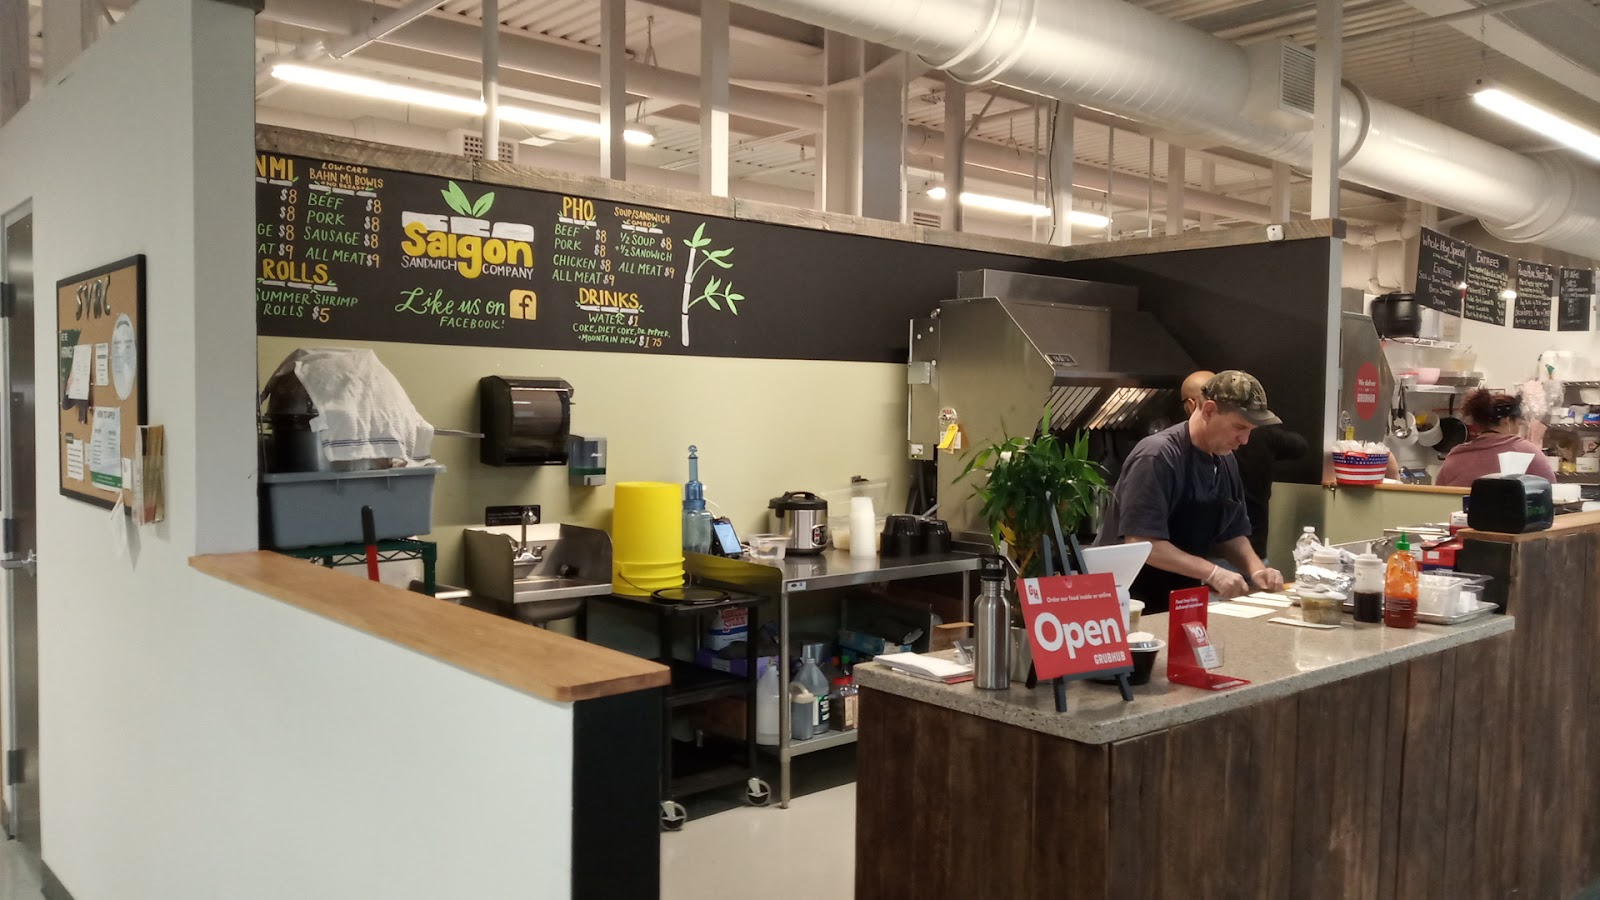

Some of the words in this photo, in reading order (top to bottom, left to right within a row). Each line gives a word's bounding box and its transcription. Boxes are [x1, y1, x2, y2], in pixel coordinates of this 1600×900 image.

[322, 162, 368, 174] LOW-CARB
[310, 168, 338, 182] BAHN
[340, 173, 352, 184] MI
[355, 176, 384, 188] BOWLS
[280, 188, 297, 204] $8
[308, 192, 344, 210] BEEF
[366, 199, 382, 214] $8
[280, 206, 295, 221] $8
[562, 196, 594, 220] PHO
[614, 206, 670, 224] SOUP/SANDWICH
[306, 210, 346, 226] PORK
[364, 216, 380, 232] $8
[258, 223, 273, 237] GE
[278, 224, 294, 240] $8
[304, 226, 360, 246] SAUSAGE
[364, 233, 379, 248] $8
[554, 224, 580, 237] BEEF
[596, 229, 606, 243] $8
[401, 222, 534, 279] Saigon
[554, 238, 582, 250] PORK
[594, 244, 606, 258] $8
[632, 234, 656, 246] SOUP
[660, 237, 672, 250] $8
[1422, 234, 1440, 250] Whole
[1440, 240, 1450, 257] Hog
[1450, 242, 1466, 258] Special
[278, 244, 294, 259] $9
[306, 247, 329, 262] ALL
[332, 250, 367, 266] MEAT
[366, 254, 380, 268] $9
[630, 247, 672, 262] SANDWICH
[262, 258, 328, 284] ROLLS
[401, 255, 458, 271] SANDWICH
[482, 263, 534, 280] COMPANY
[553, 254, 596, 270] CHICKEN
[600, 259, 611, 272] $8
[618, 262, 634, 274] ALL
[638, 264, 663, 276] MEAT
[664, 267, 676, 279] $9
[552, 270, 572, 282] ALL
[574, 272, 602, 284] MEAT
[603, 274, 615, 286] $9
[313, 293, 358, 307] SHRIMP
[395, 287, 454, 314] Like
[458, 298, 481, 316] us
[486, 300, 506, 316] on
[580, 288, 640, 309] DRINKS
[263, 303, 304, 318] ROLLS
[312, 306, 330, 322] $5
[589, 313, 625, 325] WATER
[628, 315, 639, 327] $1
[440, 316, 504, 329] FACEBOOK!
[598, 326, 616, 334] DIET
[620, 336, 638, 345] DEW
[1034, 612, 1122, 660] Open
[1093, 651, 1126, 664] GRUBHUB
